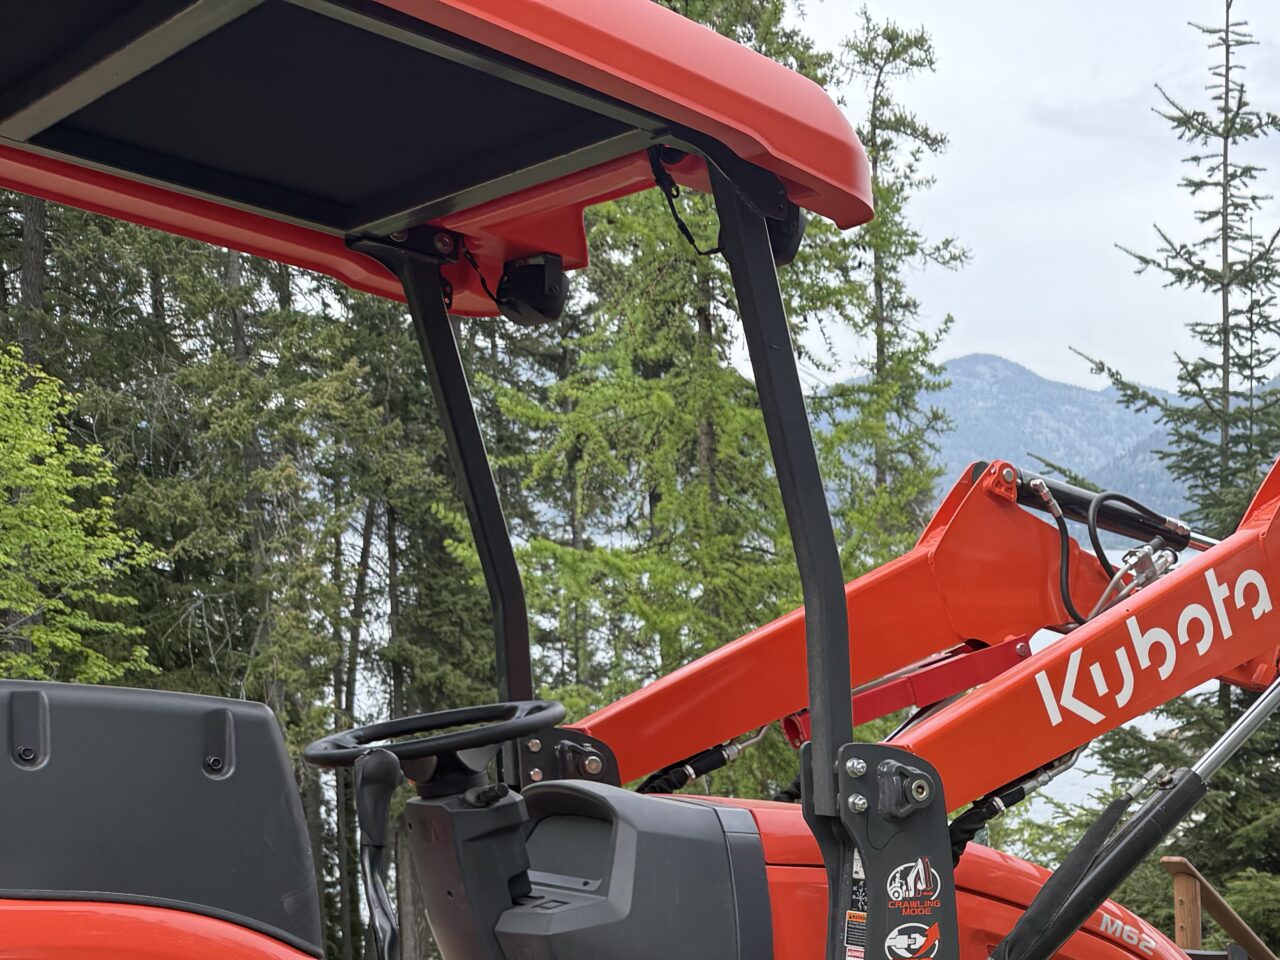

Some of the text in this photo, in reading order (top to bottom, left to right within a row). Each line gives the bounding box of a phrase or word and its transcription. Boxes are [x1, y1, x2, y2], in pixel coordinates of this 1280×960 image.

[1035, 567, 1273, 727] Kubota
[888, 900, 941, 908] CRAWLING
[902, 907, 932, 916] MODE
[1100, 913, 1156, 956] M62
